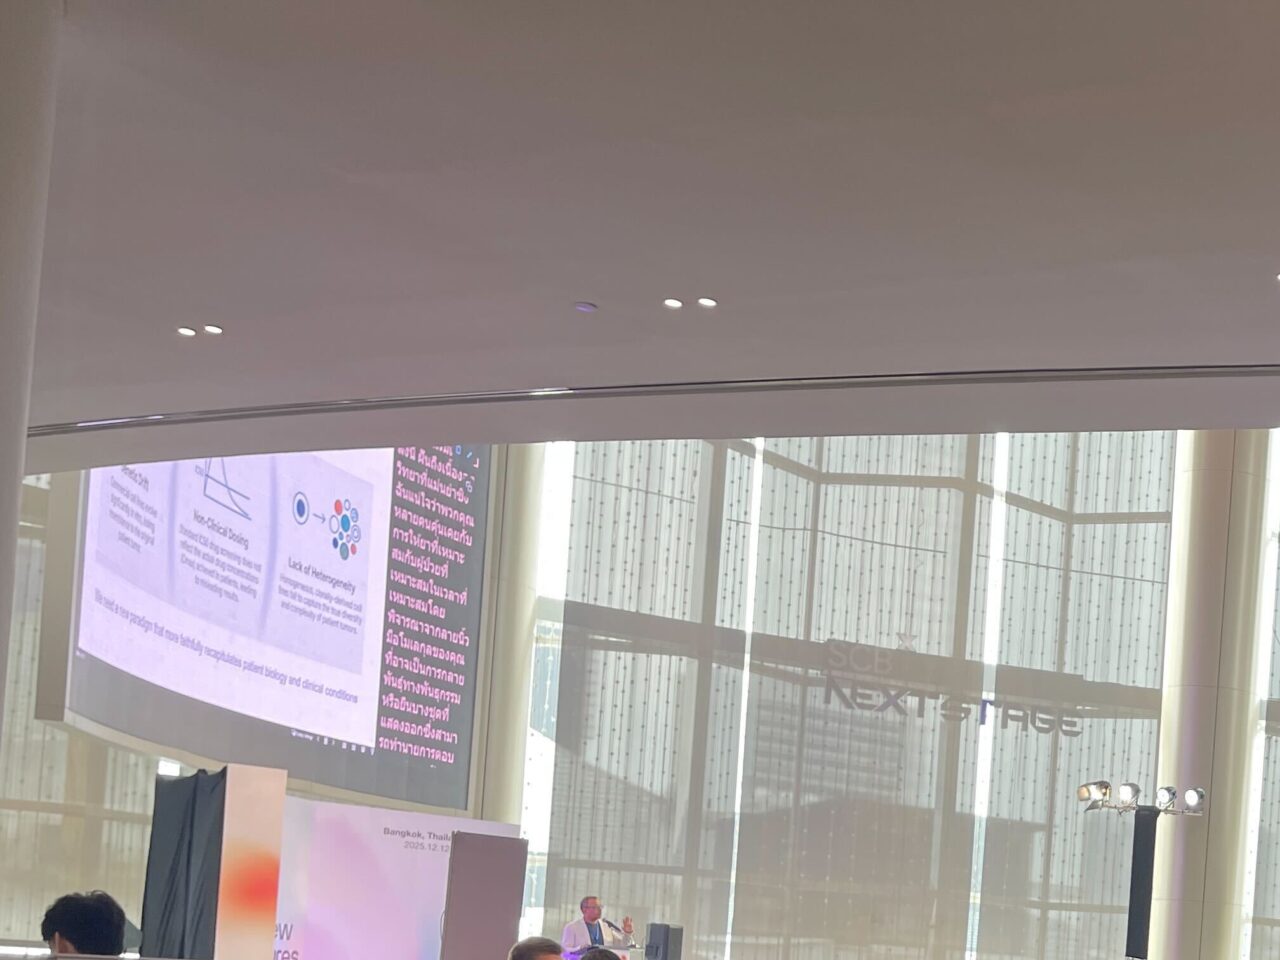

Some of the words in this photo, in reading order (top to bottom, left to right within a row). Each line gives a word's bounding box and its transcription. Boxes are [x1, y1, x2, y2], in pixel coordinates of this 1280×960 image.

[288, 556, 303, 572] Lack
[304, 564, 311, 576] of
[383, 827, 425, 840] Bangkok,
